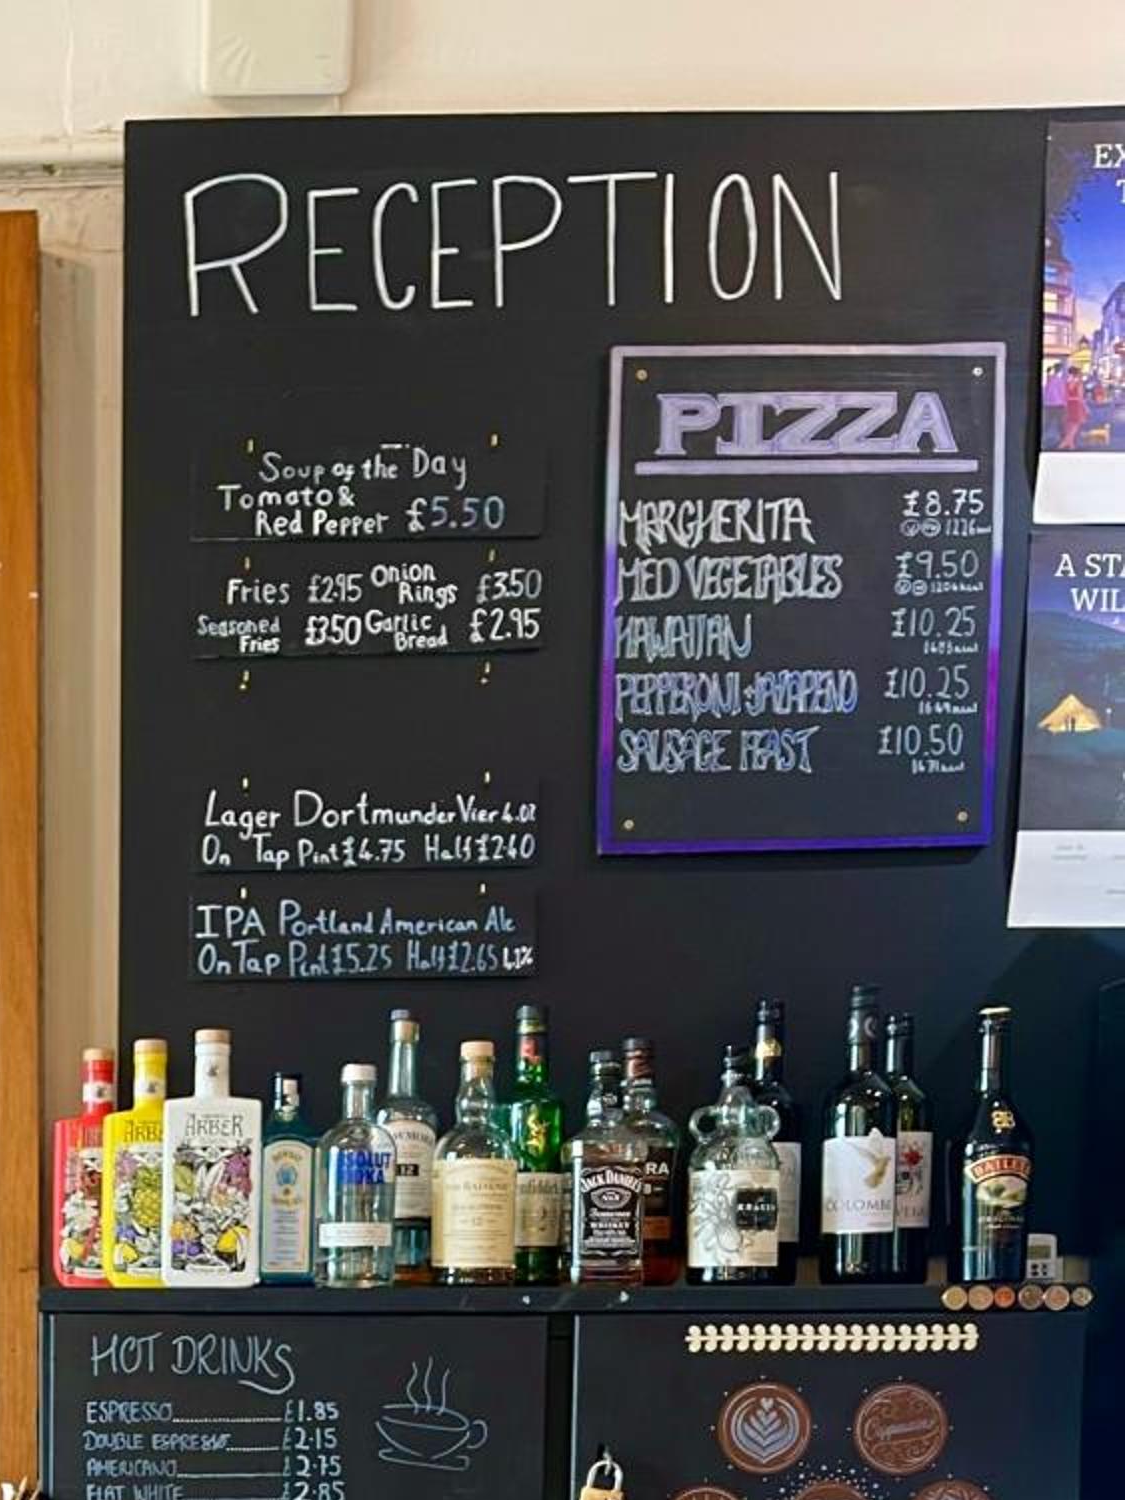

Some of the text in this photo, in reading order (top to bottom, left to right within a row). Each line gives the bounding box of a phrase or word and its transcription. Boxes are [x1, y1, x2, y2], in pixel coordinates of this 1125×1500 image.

[183, 170, 843, 317] RECEPTION
[653, 391, 959, 456] PIZZA
[259, 448, 467, 490] Soup of the Day
[255, 496, 505, 537] Red Pepper £5.50
[619, 488, 984, 555] MARGHERITA £8.75
[370, 562, 437, 588] Onion
[614, 550, 979, 606] MED VEGETABLES £9.50
[1054, 553, 1125, 578] A ST
[227, 578, 290, 605] Fries
[397, 581, 458, 609] Rings
[1070, 587, 1125, 613] WIL
[196, 614, 281, 637] Seasoned
[364, 608, 542, 643] Garlic £2.95
[394, 624, 448, 651] Bread
[891, 605, 976, 637] £10.25
[239, 635, 280, 653] Fries
[884, 664, 970, 699] £10.25
[739, 725, 821, 774] FEAST
[877, 723, 963, 756] £10.50
[205, 789, 281, 840] Lager
[293, 789, 456, 827] Dortmunder
[456, 794, 499, 824] Vier
[202, 834, 231, 866] On
[253, 832, 290, 870] Tap
[297, 838, 340, 867] Pint
[342, 836, 406, 867] £4.75
[424, 834, 472, 863] Half
[196, 899, 515, 938] IPA Portland American Ale
[197, 944, 231, 975] On
[231, 939, 281, 975] Tap
[124, 1119, 162, 1143] ARB
[185, 1112, 244, 1138] ARBER
[90, 1331, 295, 1395] HOT DRINKS
[86, 1400, 172, 1424] ESPRESSO
[82, 1430, 144, 1451] DOUBLE
[151, 1433, 232, 1452] ESPRESSO
[86, 1458, 178, 1478] AMERICANO
